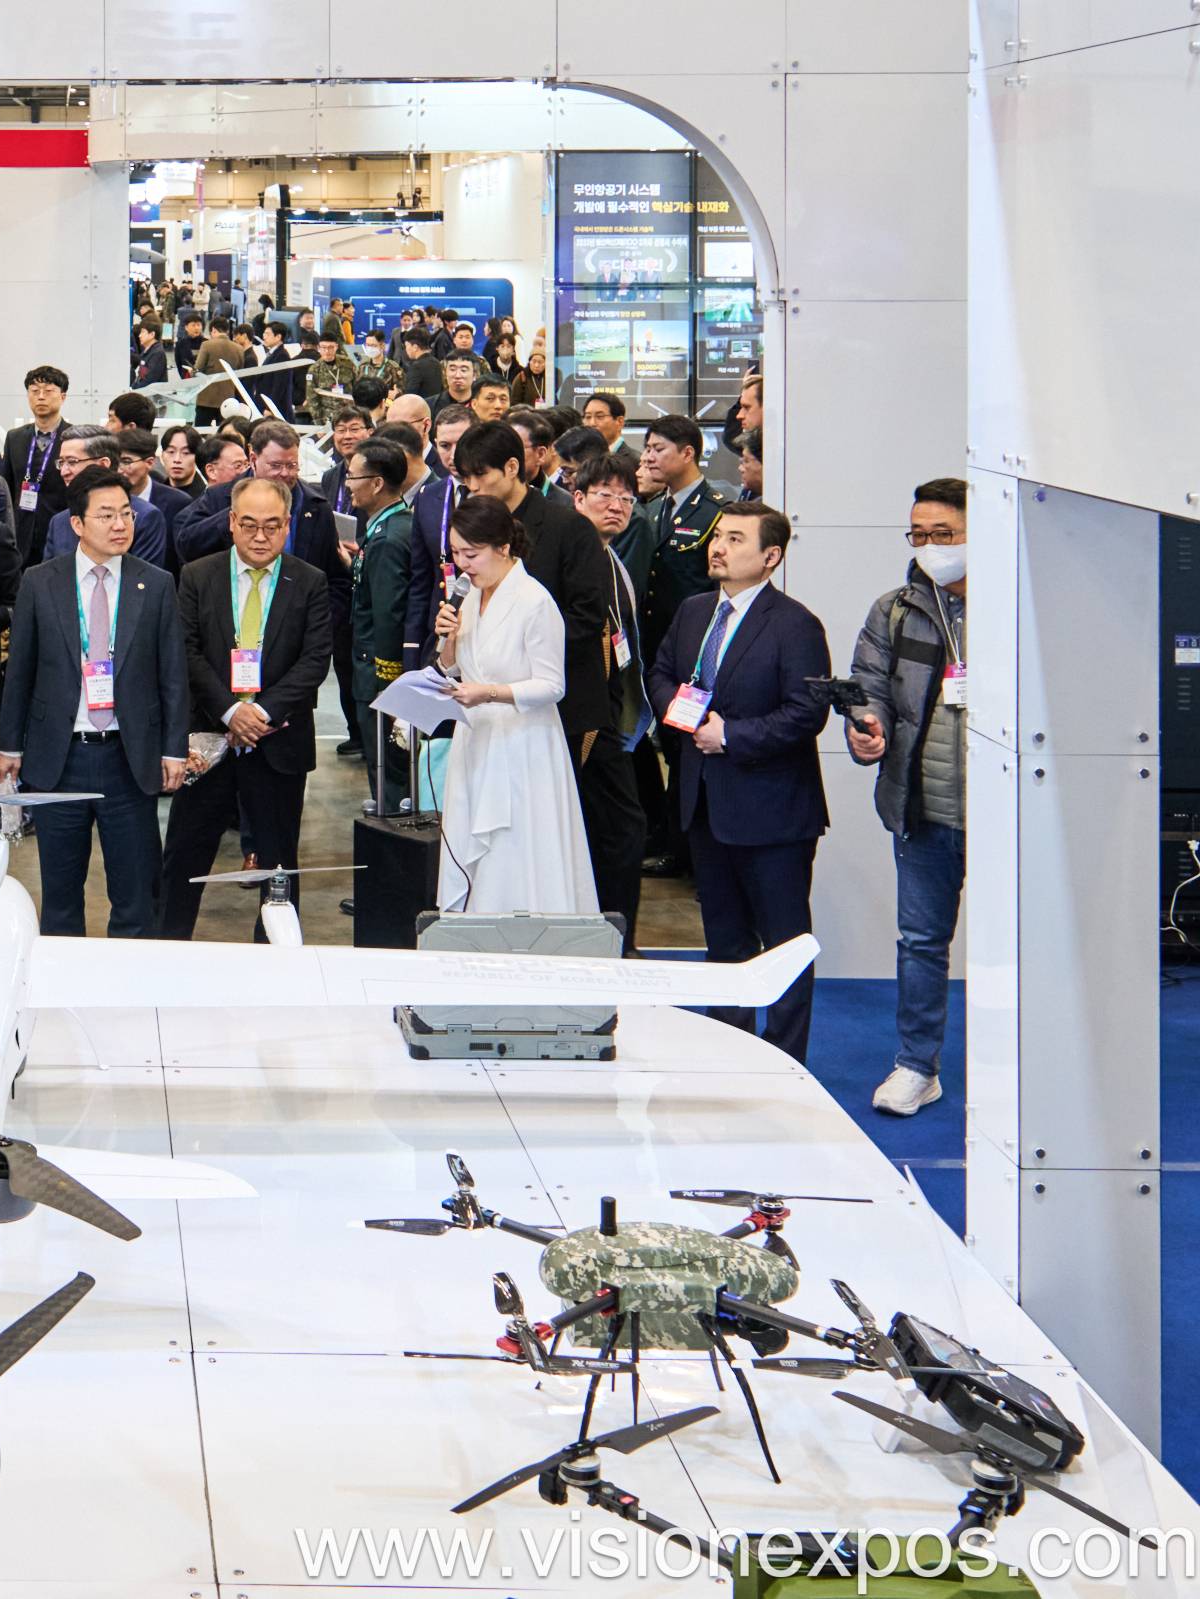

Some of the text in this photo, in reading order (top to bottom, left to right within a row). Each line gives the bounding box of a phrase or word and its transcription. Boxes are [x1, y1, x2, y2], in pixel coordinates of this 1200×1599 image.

[573, 184, 661, 196] 무인항공기 시스템
[573, 201, 605, 213] 개발에
[607, 201, 650, 213] 필수적인
[651, 201, 695, 213] 핵심기술
